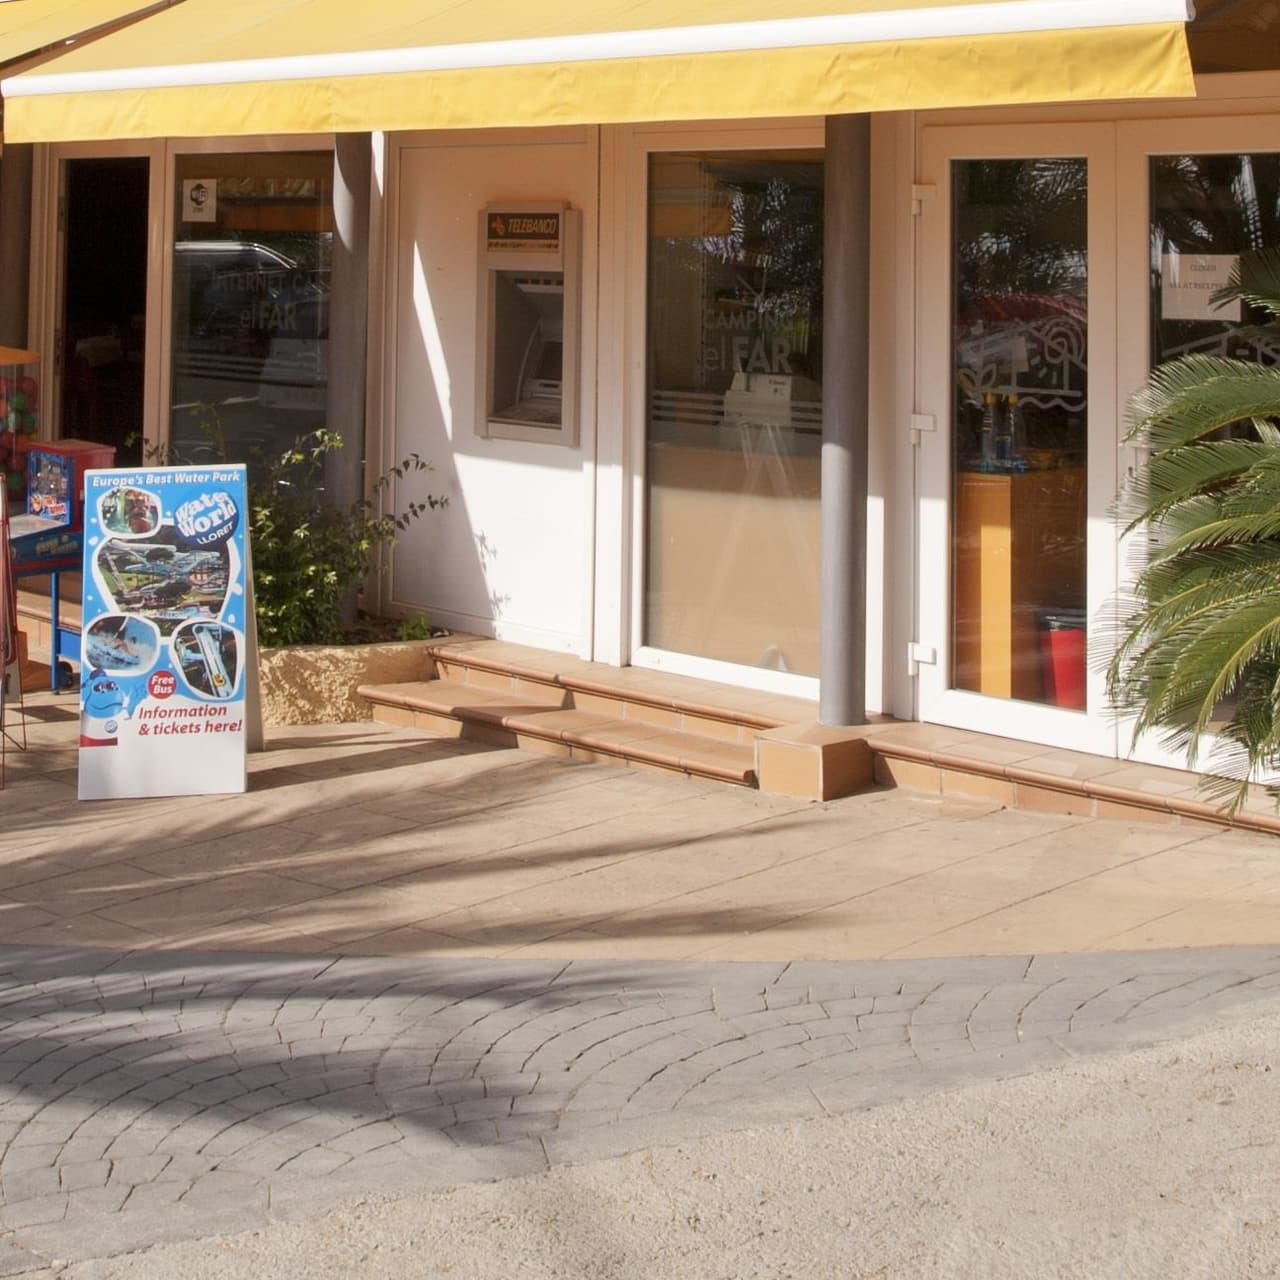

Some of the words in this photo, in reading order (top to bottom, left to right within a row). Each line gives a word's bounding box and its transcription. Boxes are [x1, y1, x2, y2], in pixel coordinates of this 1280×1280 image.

[507, 217, 557, 234] TELEBANCO
[704, 309, 791, 331] CAMPING
[731, 335, 793, 373] FAR
[92, 474, 144, 489] Europe's
[145, 473, 172, 485] Best
[174, 472, 210, 484] Water
[211, 470, 241, 482] Park
[177, 496, 237, 538] World
[195, 521, 234, 546] LLORET
[151, 674, 175, 685] Free
[153, 684, 173, 695] Bus
[138, 703, 228, 720] Information
[138, 722, 151, 736] &
[153, 721, 202, 735] tickets
[204, 719, 243, 734] here!
